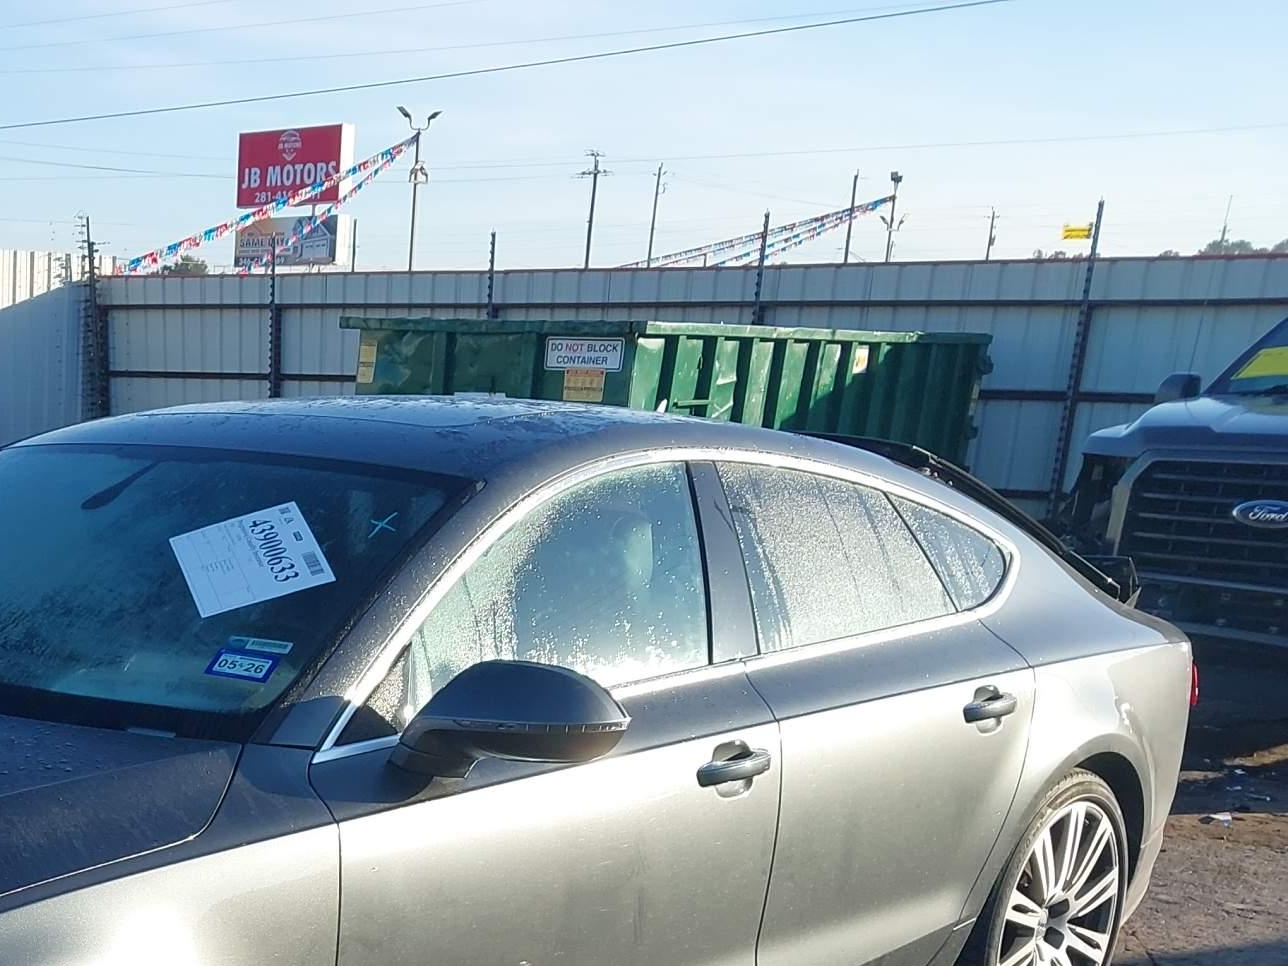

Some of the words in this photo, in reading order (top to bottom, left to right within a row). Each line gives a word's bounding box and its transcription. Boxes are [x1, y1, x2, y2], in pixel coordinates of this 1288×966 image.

[242, 167, 261, 189] JB
[266, 161, 337, 187] MOTORS
[551, 343, 563, 351] DO
[565, 343, 584, 352] NOT
[587, 343, 619, 353] BLOCK
[556, 355, 608, 365] CONTAINER
[249, 520, 299, 582] 43900633
